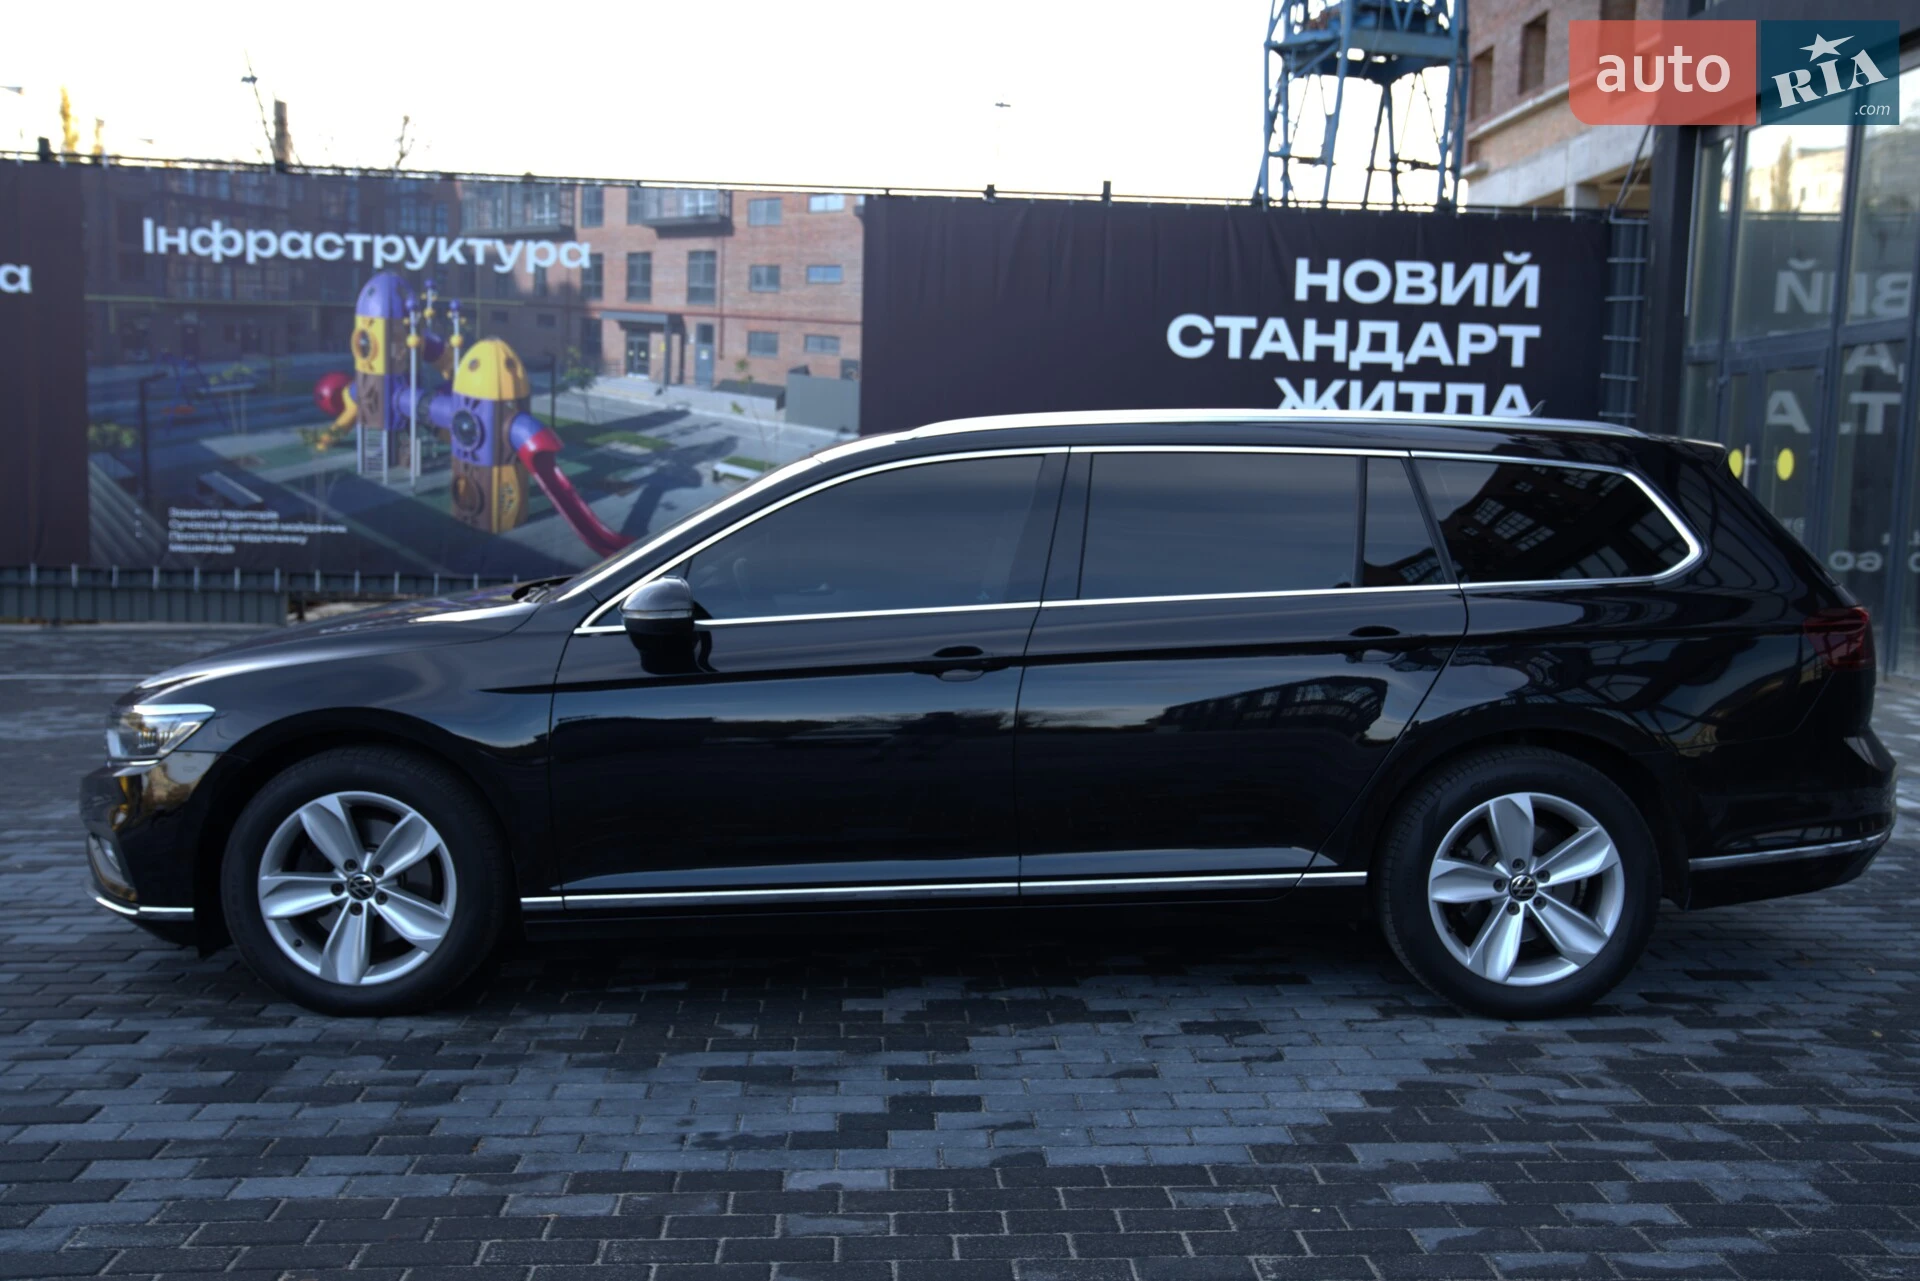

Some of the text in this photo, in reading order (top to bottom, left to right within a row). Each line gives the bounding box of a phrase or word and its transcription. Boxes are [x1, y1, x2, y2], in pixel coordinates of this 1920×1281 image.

[142, 217, 592, 273] Інфраструктура
[1294, 251, 1541, 308] НОВИЙ
[1166, 313, 1542, 372] СТАНДАРТ
